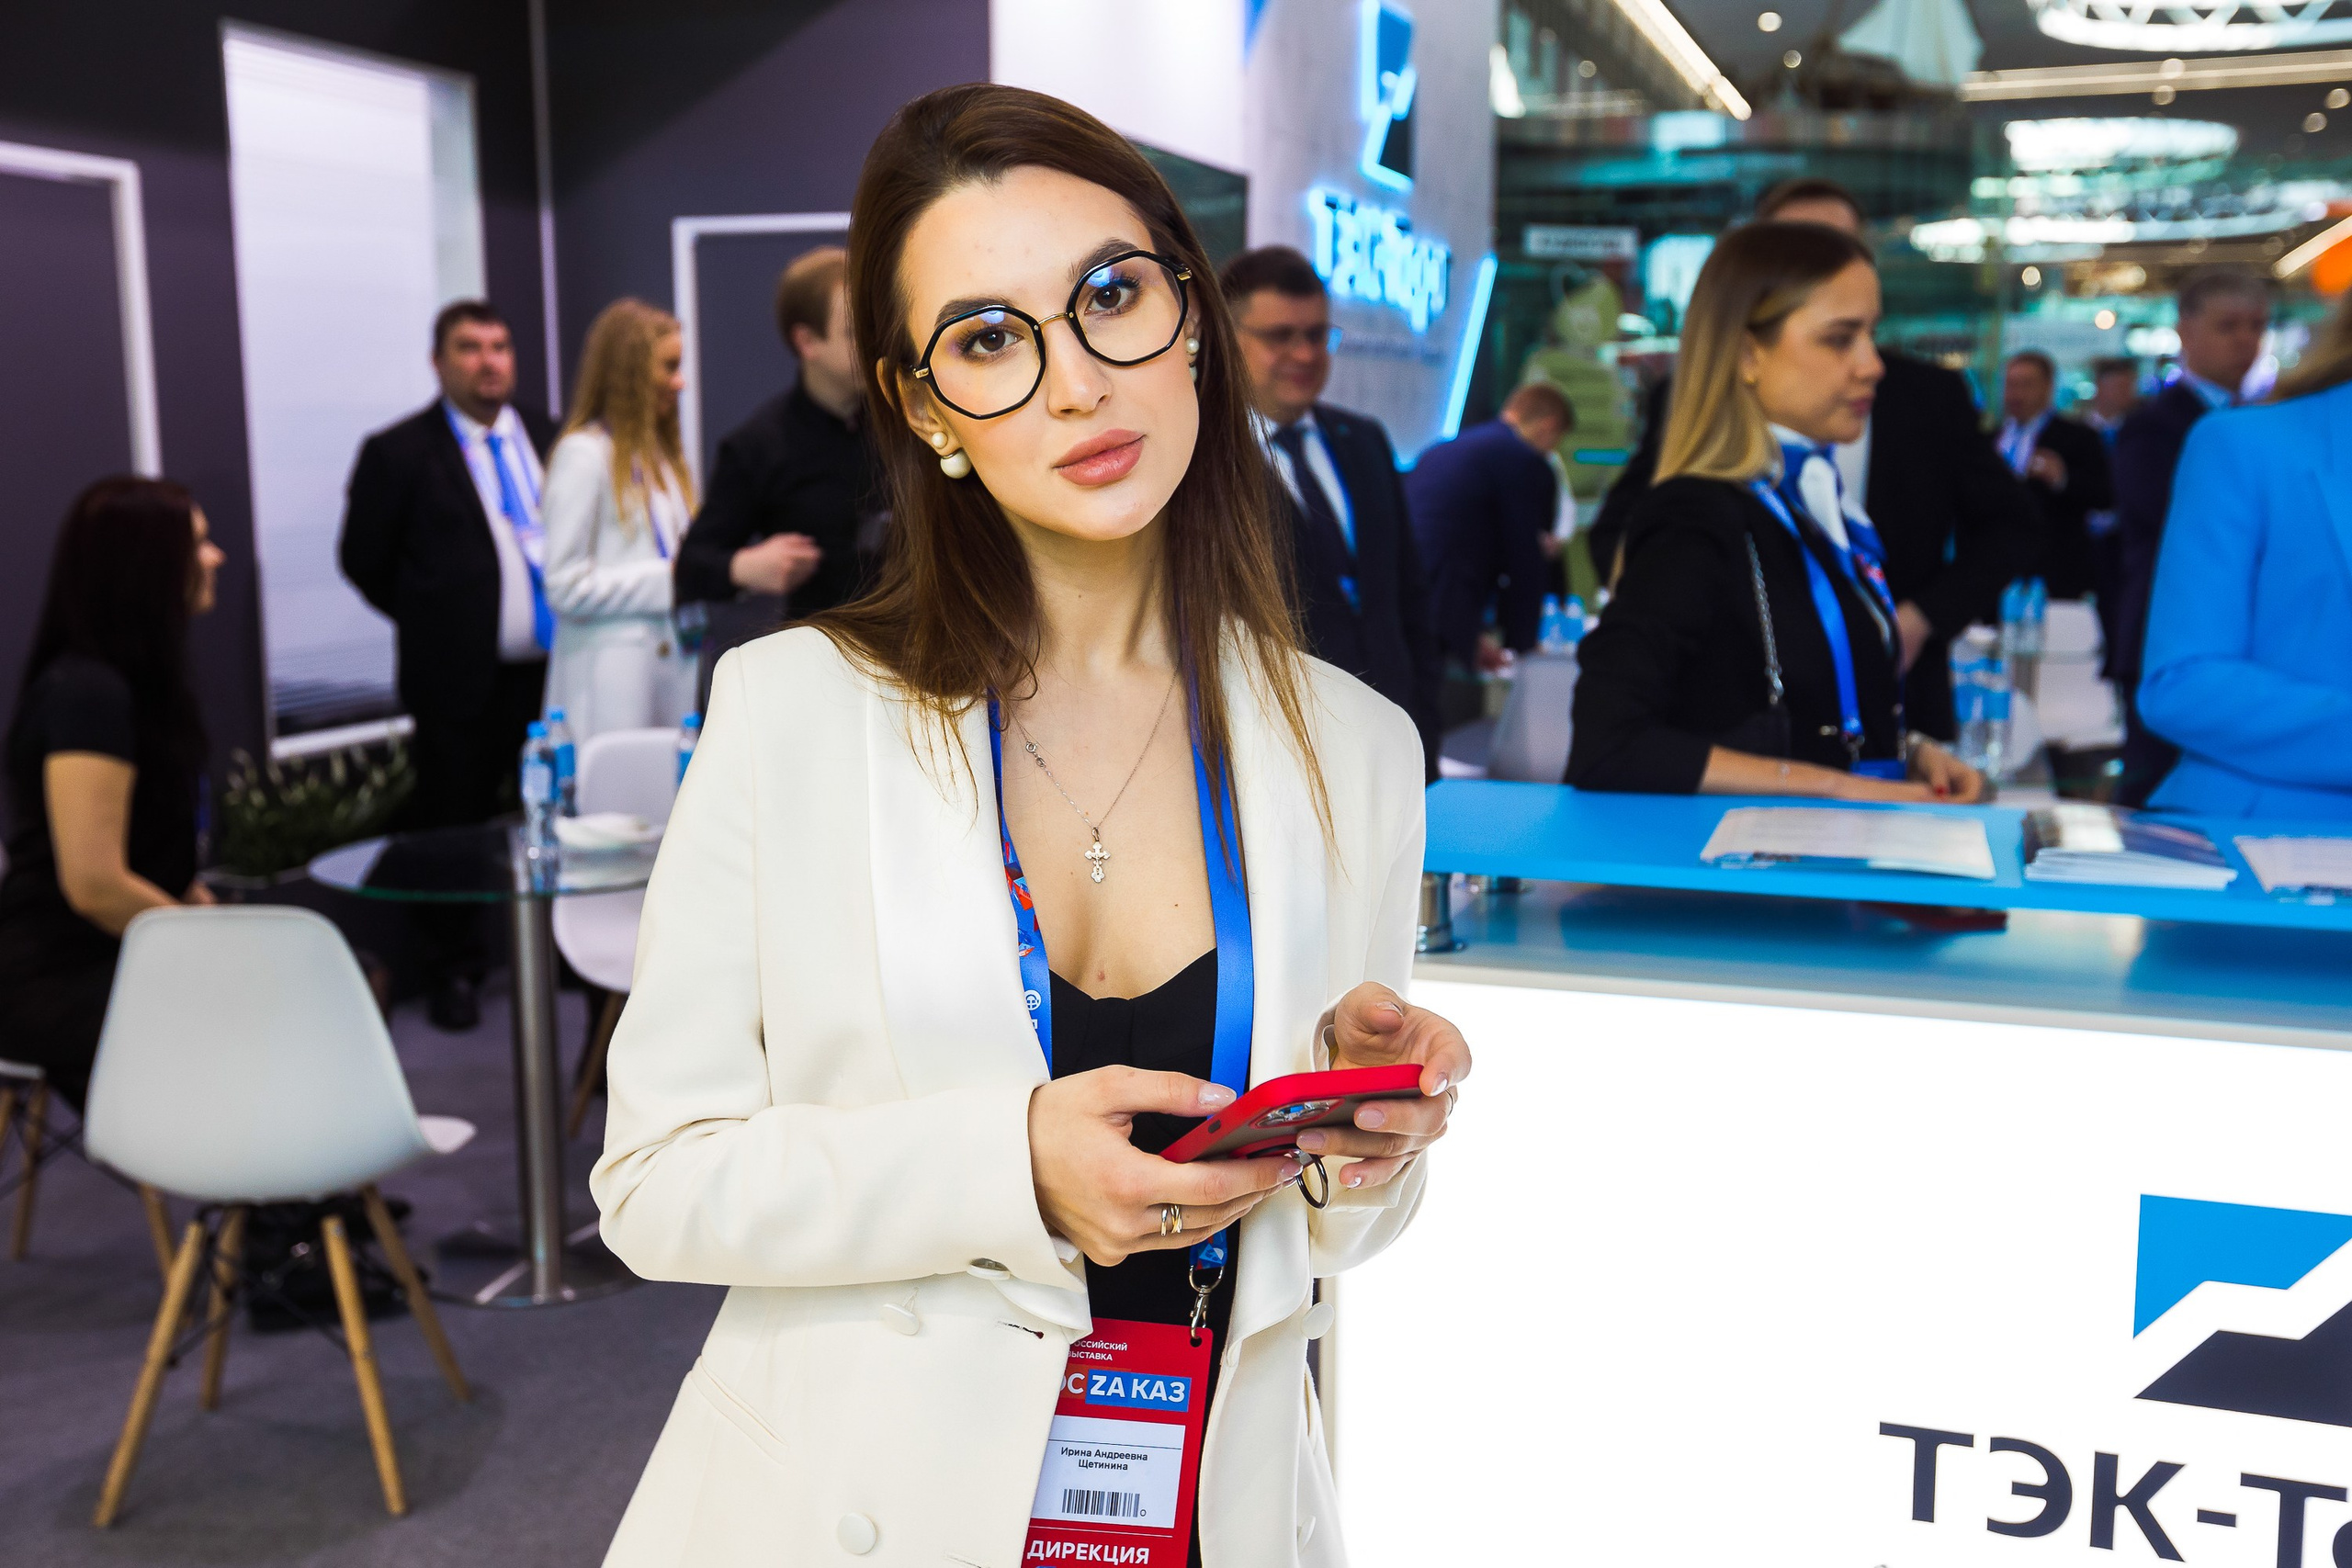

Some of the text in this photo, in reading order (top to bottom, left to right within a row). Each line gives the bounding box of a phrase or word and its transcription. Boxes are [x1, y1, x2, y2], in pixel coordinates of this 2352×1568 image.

[1073, 1340, 1128, 1351] ОССИЙСКИЙ
[1061, 1447, 1148, 1461] Ирина Андреевна
[1079, 1459, 1128, 1470] Щетинина
[1879, 1421, 2352, 1568] ТЭК-Т
[1026, 1540, 1150, 1565] ДИРЕКЦИЯ
